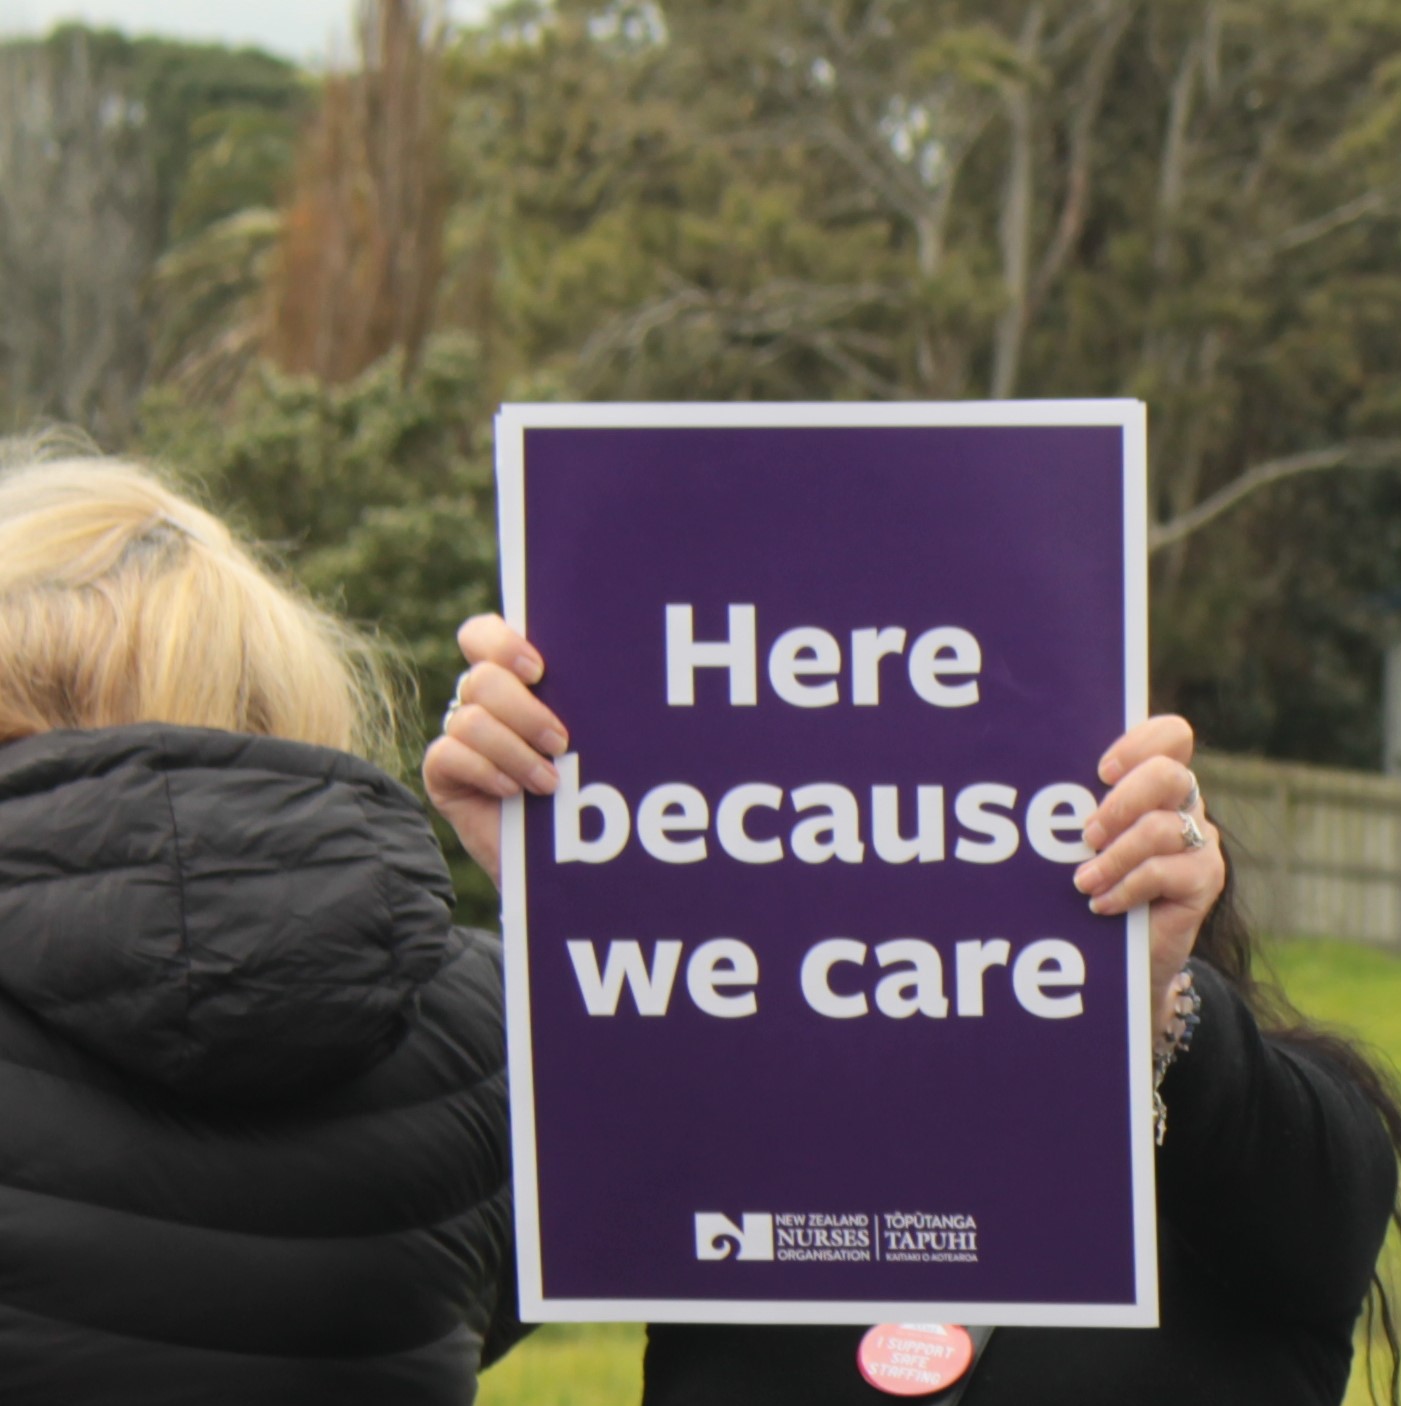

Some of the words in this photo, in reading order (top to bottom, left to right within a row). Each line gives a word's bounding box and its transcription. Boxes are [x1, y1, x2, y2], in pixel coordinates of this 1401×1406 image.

[665, 604, 982, 708] Here
[553, 753, 1096, 864] because
[566, 938, 759, 1018] we
[800, 938, 1086, 1019] care
[775, 1214, 806, 1226] NEW
[808, 1214, 869, 1227] ZEALAND
[776, 1228, 870, 1247] NURSES
[884, 1230, 977, 1250] TAPUHI
[777, 1249, 871, 1261] ORGANISATION
[887, 1337, 955, 1360] SUPPORT
[891, 1351, 930, 1368] SAFE
[868, 1362, 942, 1385] STAFFING
